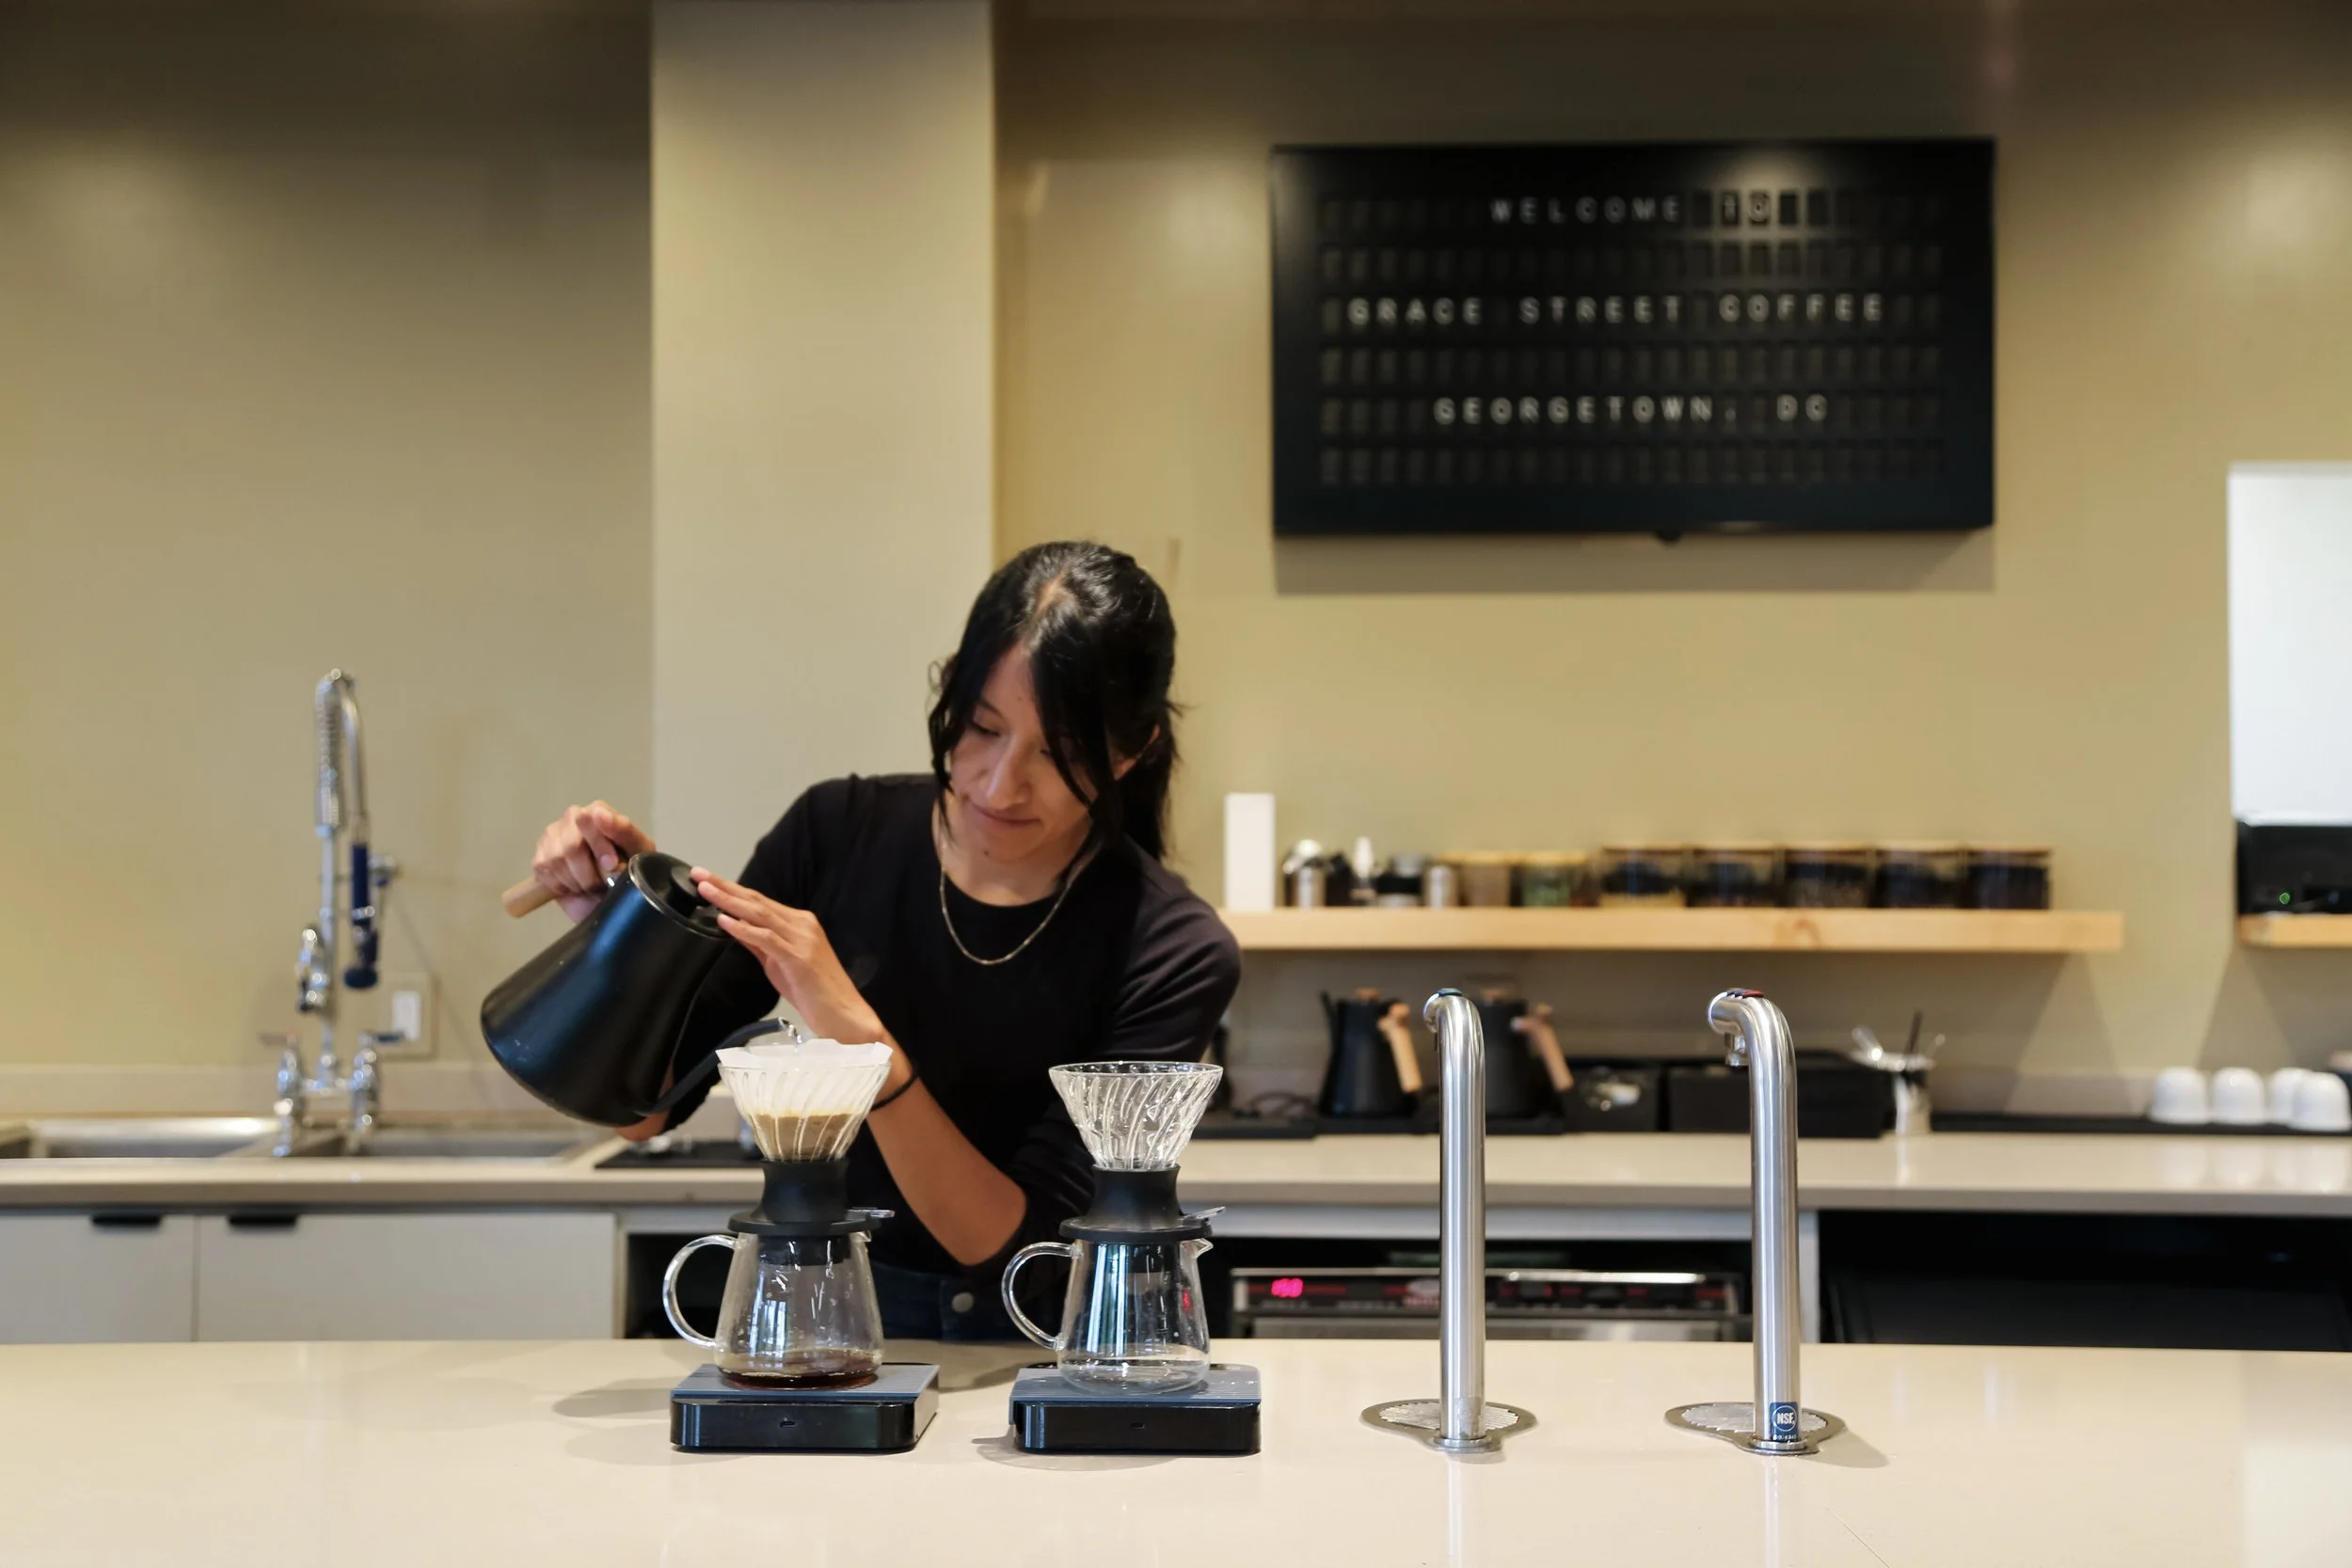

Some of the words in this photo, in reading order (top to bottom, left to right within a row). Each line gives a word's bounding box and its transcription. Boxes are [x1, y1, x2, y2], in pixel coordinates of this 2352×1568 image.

[1490, 196, 1679, 224] WELCOME
[1347, 296, 1480, 325] GRACE
[1519, 295, 1680, 325] STREET
[1719, 293, 1881, 323] COFFEE
[1776, 393, 1827, 421] DC
[1776, 1412, 1795, 1425] NSF
